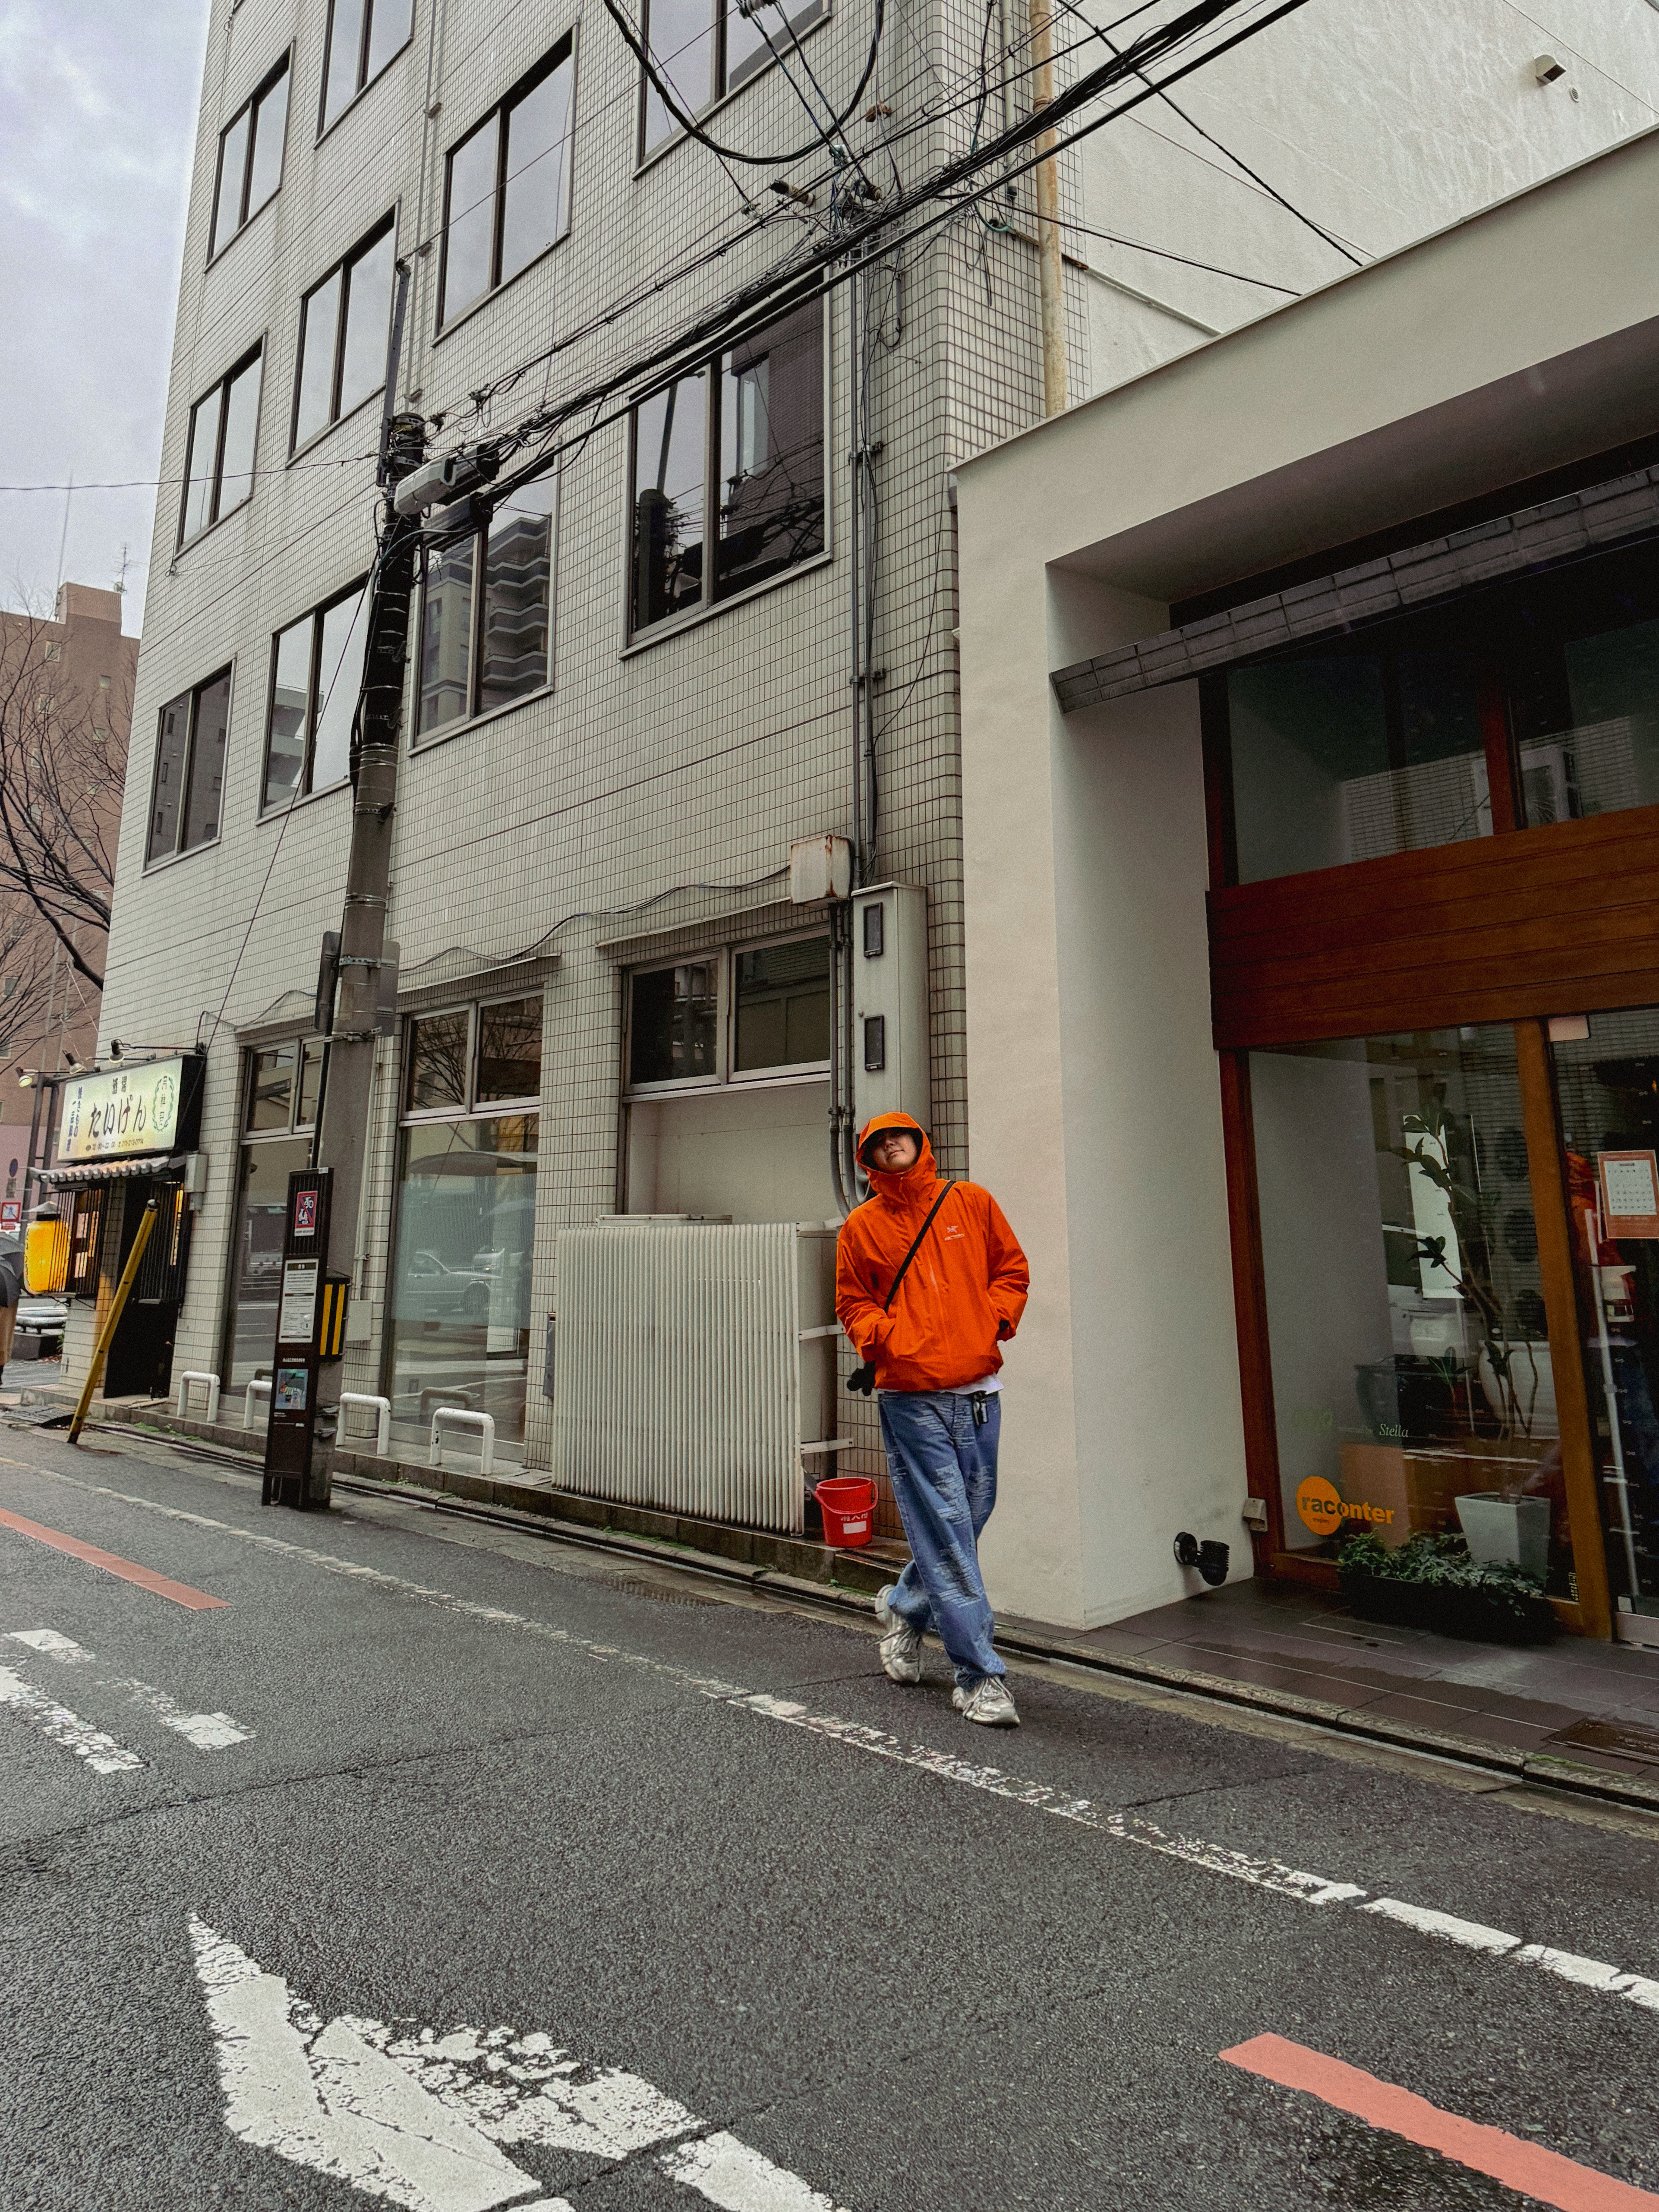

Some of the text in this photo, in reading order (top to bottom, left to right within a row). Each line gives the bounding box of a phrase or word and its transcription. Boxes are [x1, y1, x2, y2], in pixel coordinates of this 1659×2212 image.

[112, 1076, 127, 1094] 酒場
[88, 1094, 147, 1138] たいげん
[1379, 1423, 1409, 1438] Stella
[1302, 1497, 1395, 1524] raconter
